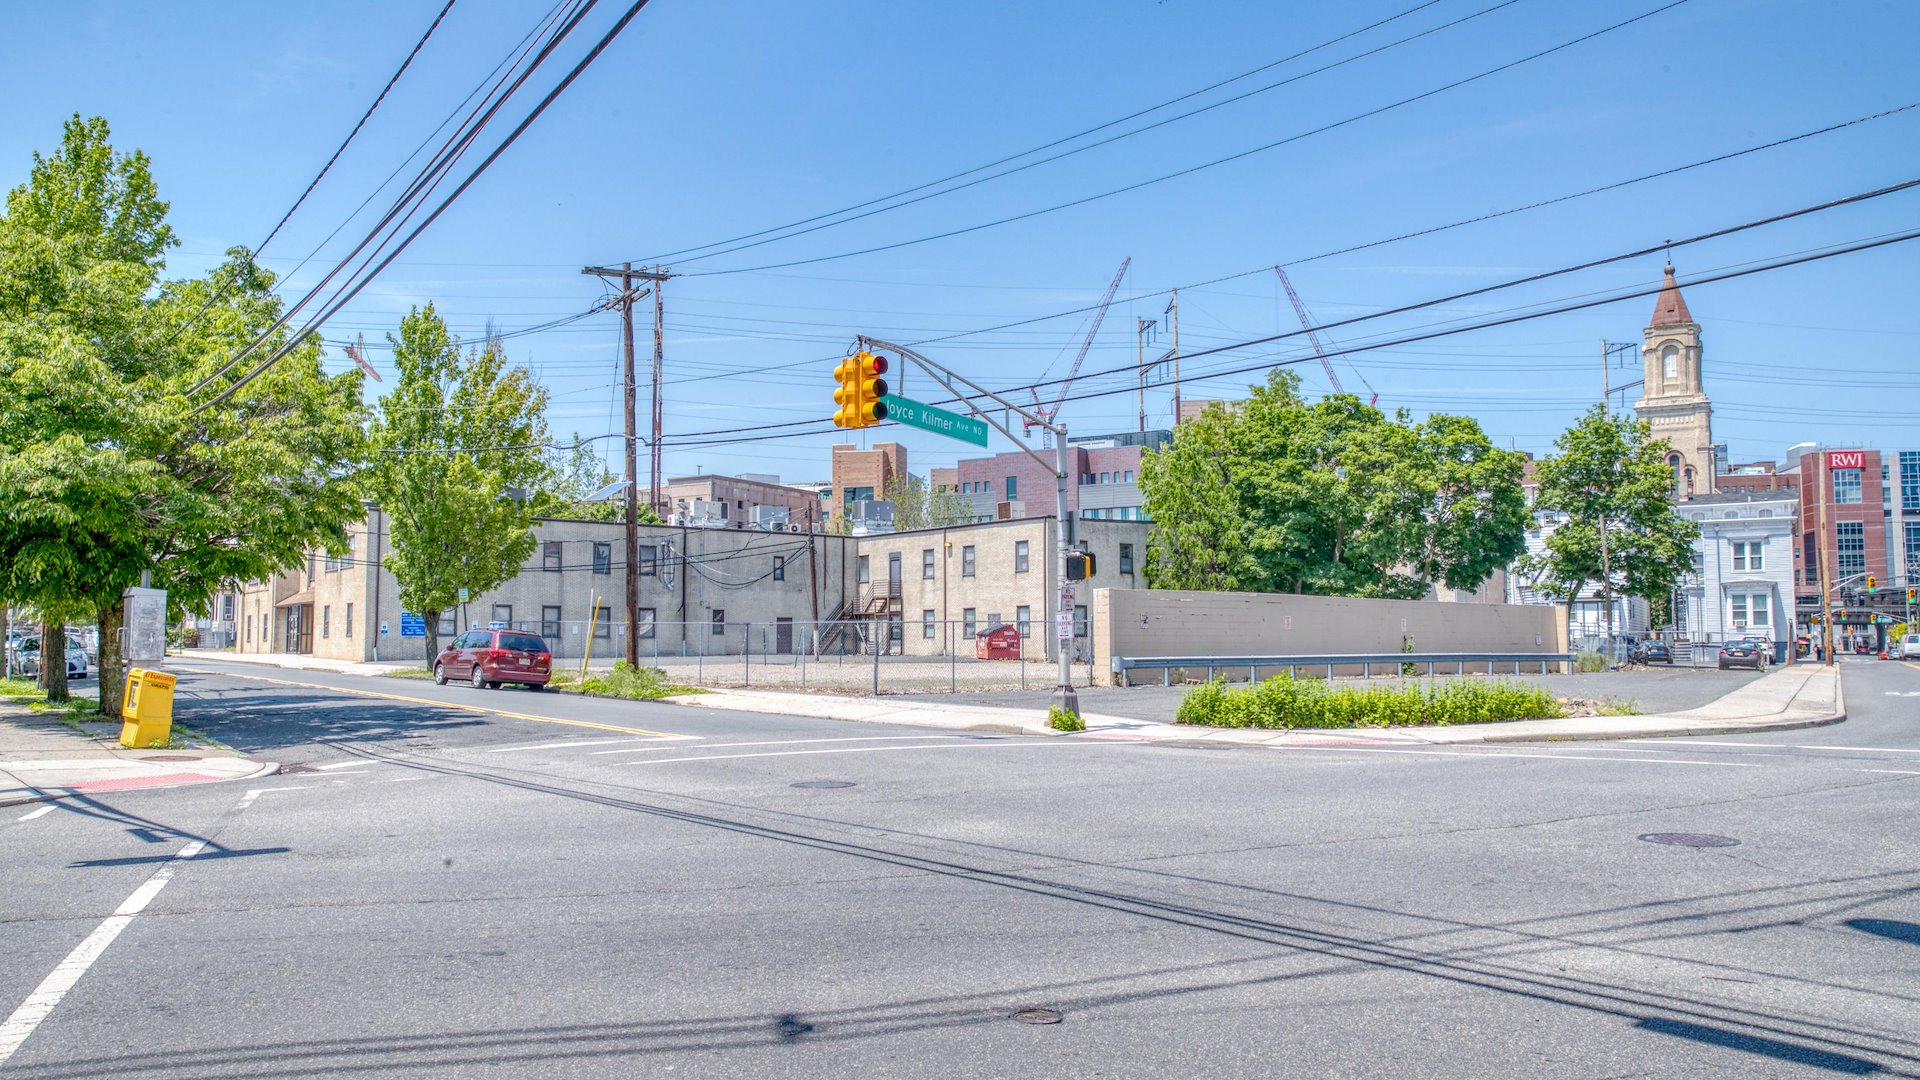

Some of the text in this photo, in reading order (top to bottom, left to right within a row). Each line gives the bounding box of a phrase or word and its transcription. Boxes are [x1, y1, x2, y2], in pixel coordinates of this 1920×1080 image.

[921, 410, 953, 431] Kilmer
[956, 421, 969, 432] Ave
[1831, 453, 1863, 468] RWJ
